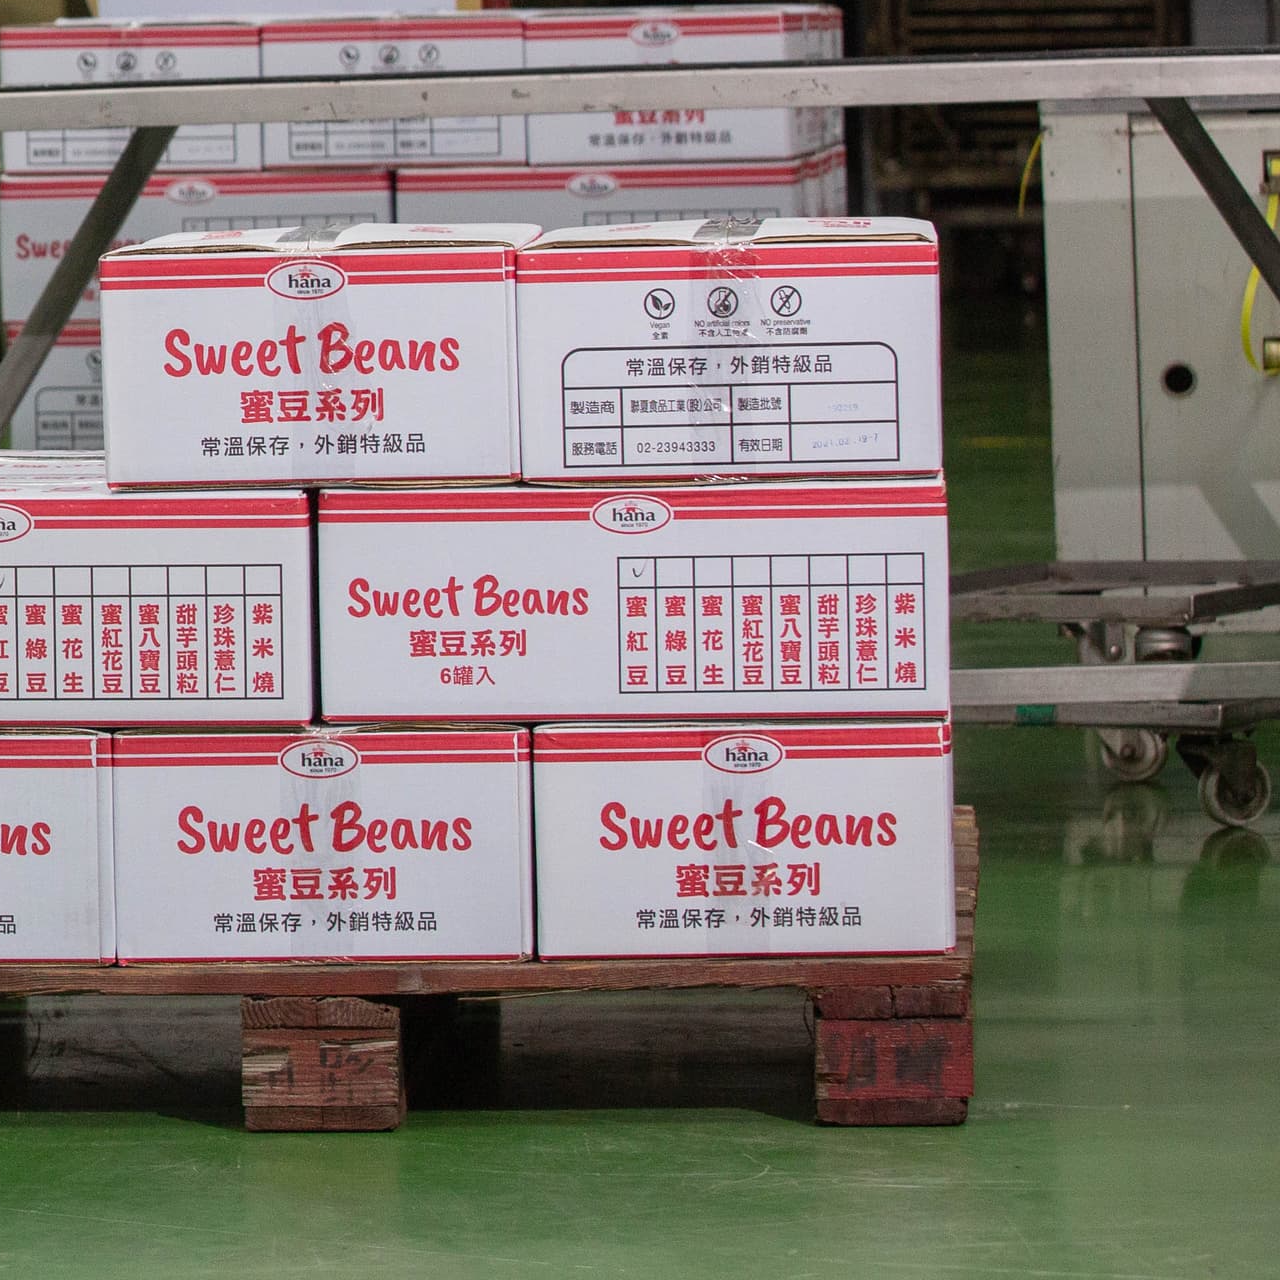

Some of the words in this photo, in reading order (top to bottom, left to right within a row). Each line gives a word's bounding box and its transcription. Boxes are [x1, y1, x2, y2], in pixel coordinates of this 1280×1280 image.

[15, 234, 68, 260] Swe
[288, 275, 331, 288] hana
[650, 322, 670, 330] Vegan
[694, 320, 705, 328] NO
[773, 319, 811, 328] preservative
[164, 325, 305, 377] Sweet
[317, 322, 459, 374] Beans
[626, 355, 832, 376] 常溫保存，外銷特級品
[241, 388, 384, 423] 蜜豆系列
[570, 400, 614, 414] 製造商
[737, 397, 782, 411] 製造批號
[201, 432, 425, 457] 常溫保存，外銷特級品
[572, 442, 617, 456] 服務電話
[637, 441, 715, 453] 02-23943333
[738, 438, 782, 452] 有效日期
[612, 509, 655, 521] hana
[348, 576, 463, 618] Sweet
[473, 574, 588, 617] Beans
[26, 605, 46, 692] 蜜綠豆
[62, 605, 82, 692] 蜜花生
[102, 604, 122, 693] 蜜紅花豆
[139, 604, 160, 693] 蜜八寶豆
[176, 605, 197, 693] 甜芋頭粒
[214, 605, 235, 692] 珍珠薏仁
[253, 604, 273, 692] 紫米燒
[410, 629, 526, 657] 蜜豆系列
[626, 596, 647, 685] 蜜紅豆
[665, 596, 686, 685] 蜜綠豆
[702, 596, 723, 685] 蜜花生
[742, 595, 763, 685] 蜜紅花豆
[780, 594, 800, 684] 蜜八寶豆
[818, 595, 839, 684] 甜芋頭粒
[856, 594, 876, 683] 珍珠薏仁
[895, 593, 916, 682] 紫米燒
[440, 666, 495, 685] 6罐入
[301, 753, 344, 766] hana
[725, 748, 769, 762] hana
[178, 804, 318, 855] Sweet
[330, 801, 471, 853] Beans
[600, 800, 742, 851] Sweet
[754, 796, 896, 848] Beans
[254, 867, 396, 900] 蜜豆系列
[676, 863, 820, 897] 蜜豆系列
[214, 911, 437, 933] 常溫保存，外銷特級品
[636, 906, 861, 929] 常溫保存，外銷特級品
